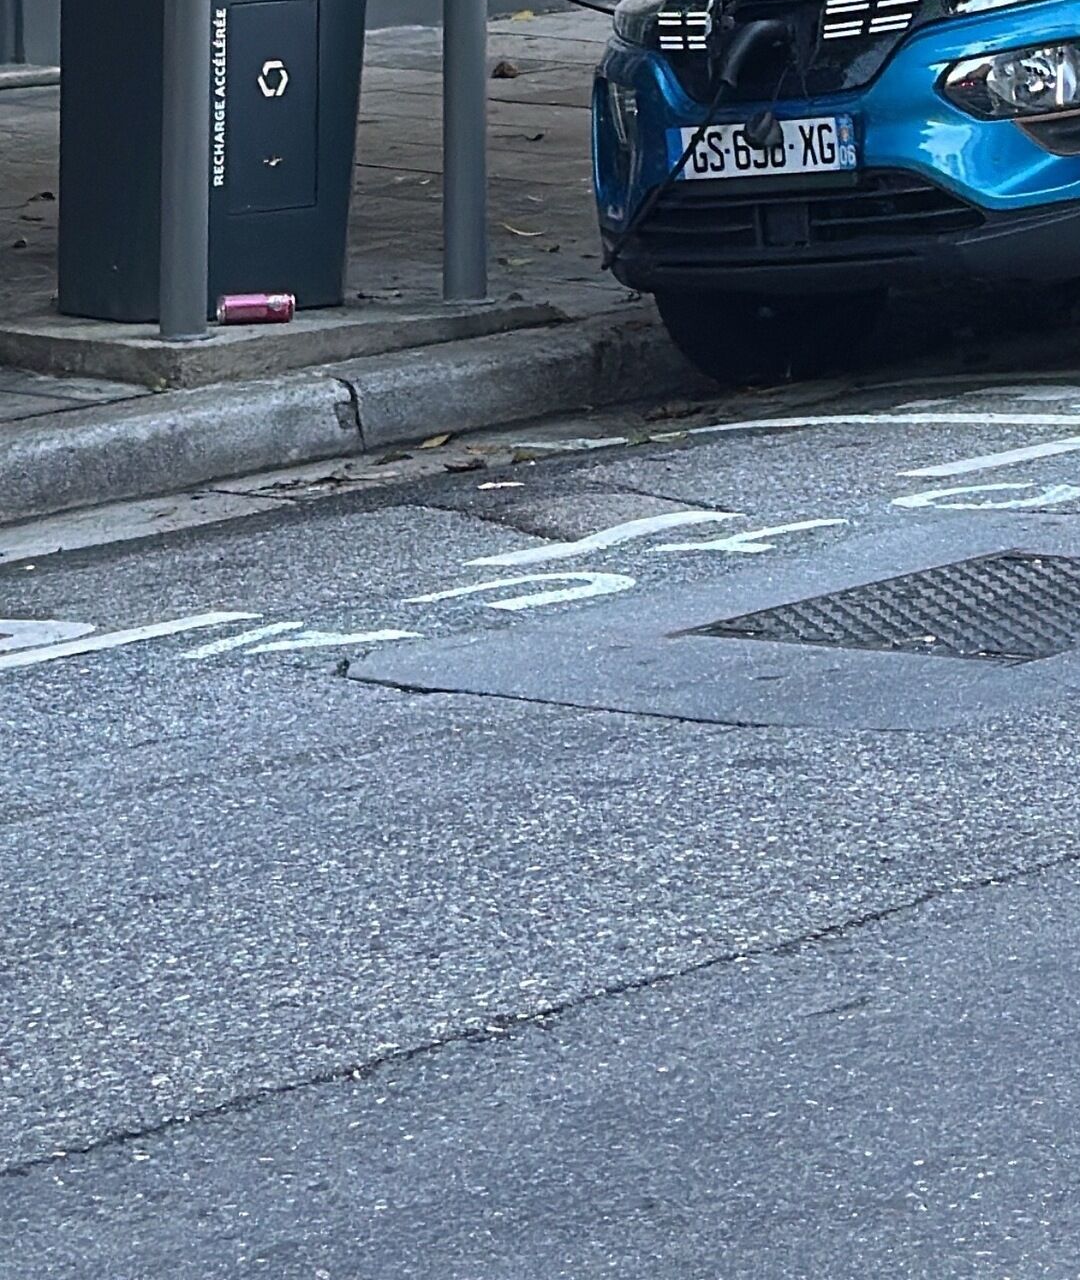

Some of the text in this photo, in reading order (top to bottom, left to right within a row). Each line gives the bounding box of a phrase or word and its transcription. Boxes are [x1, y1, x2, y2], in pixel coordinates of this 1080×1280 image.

[212, 8, 227, 187] RECHARGE ACCÉLÉRÉE
[840, 144, 857, 166] 06
